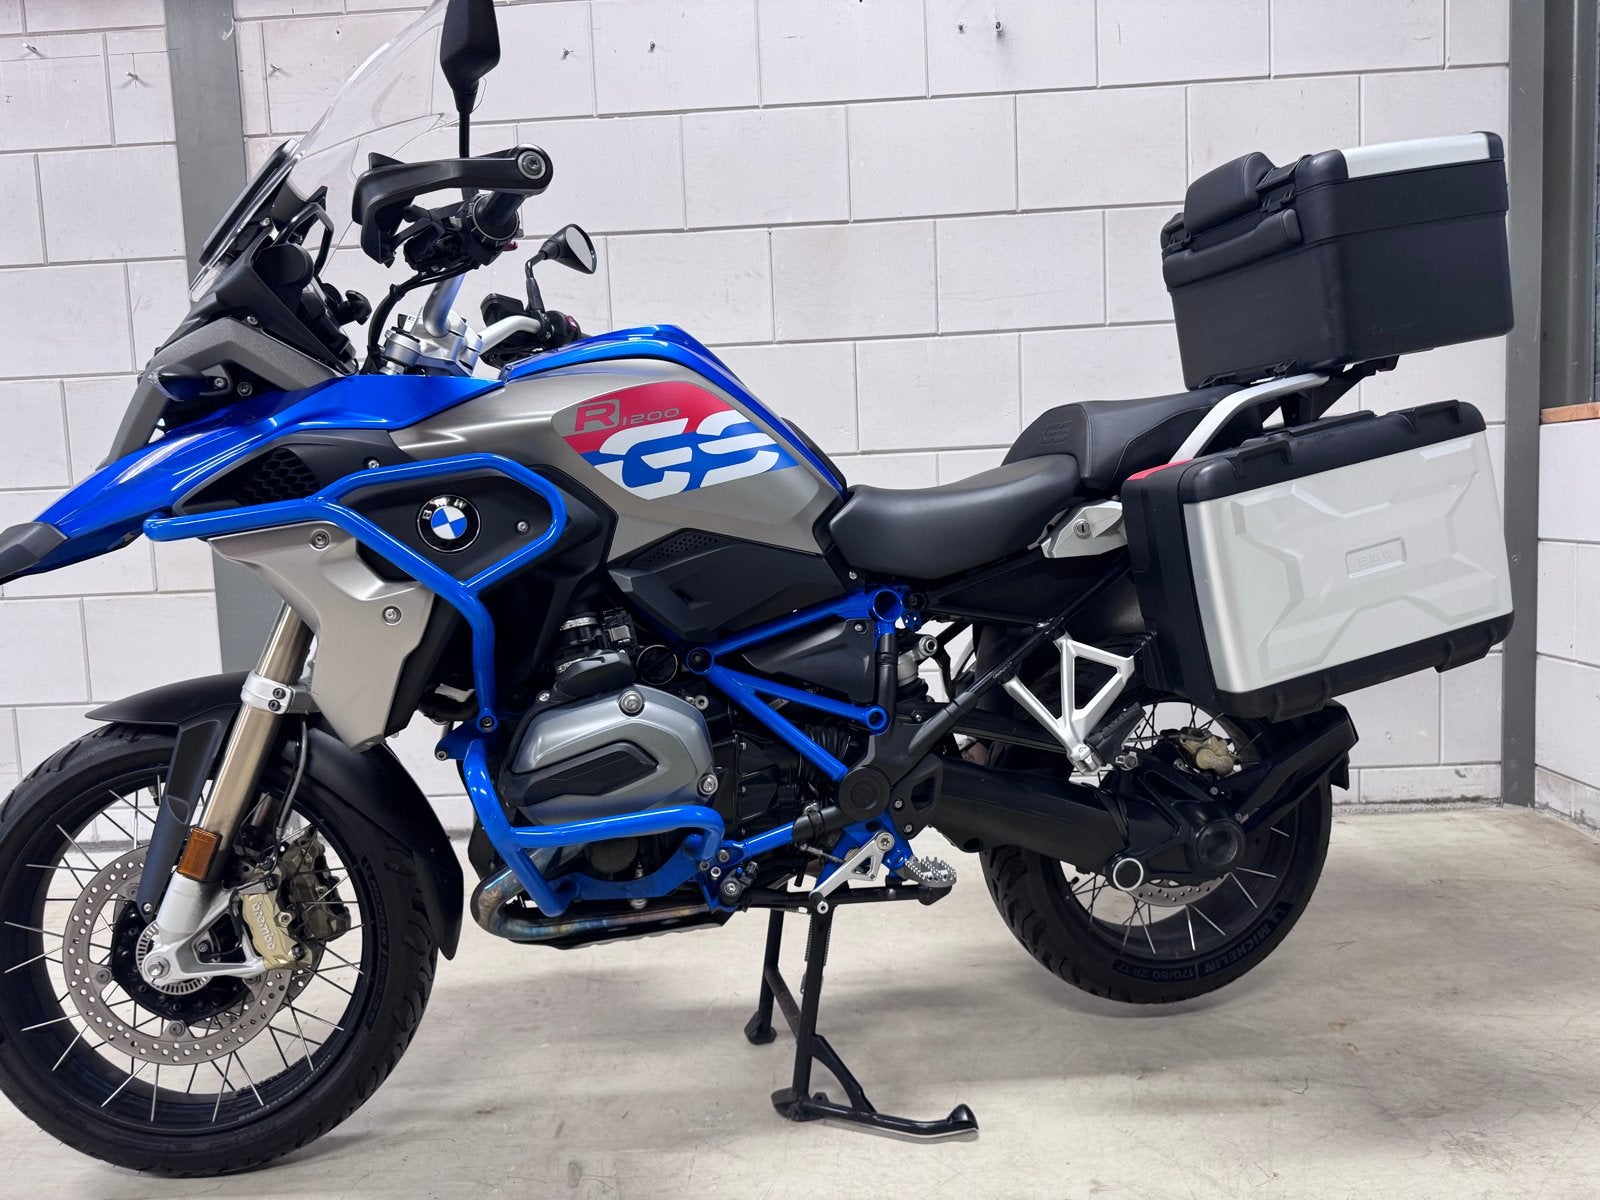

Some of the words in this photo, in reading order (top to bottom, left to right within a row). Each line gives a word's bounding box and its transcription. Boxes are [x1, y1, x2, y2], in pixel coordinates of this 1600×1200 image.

[573, 401, 618, 432] R
[621, 406, 680, 427] 1200
[594, 409, 780, 500] GS
[421, 497, 467, 521] BMW
[253, 901, 276, 950] brembo
[1204, 923, 1272, 974] MICHELIN
[1152, 967, 1195, 980] 170/60
